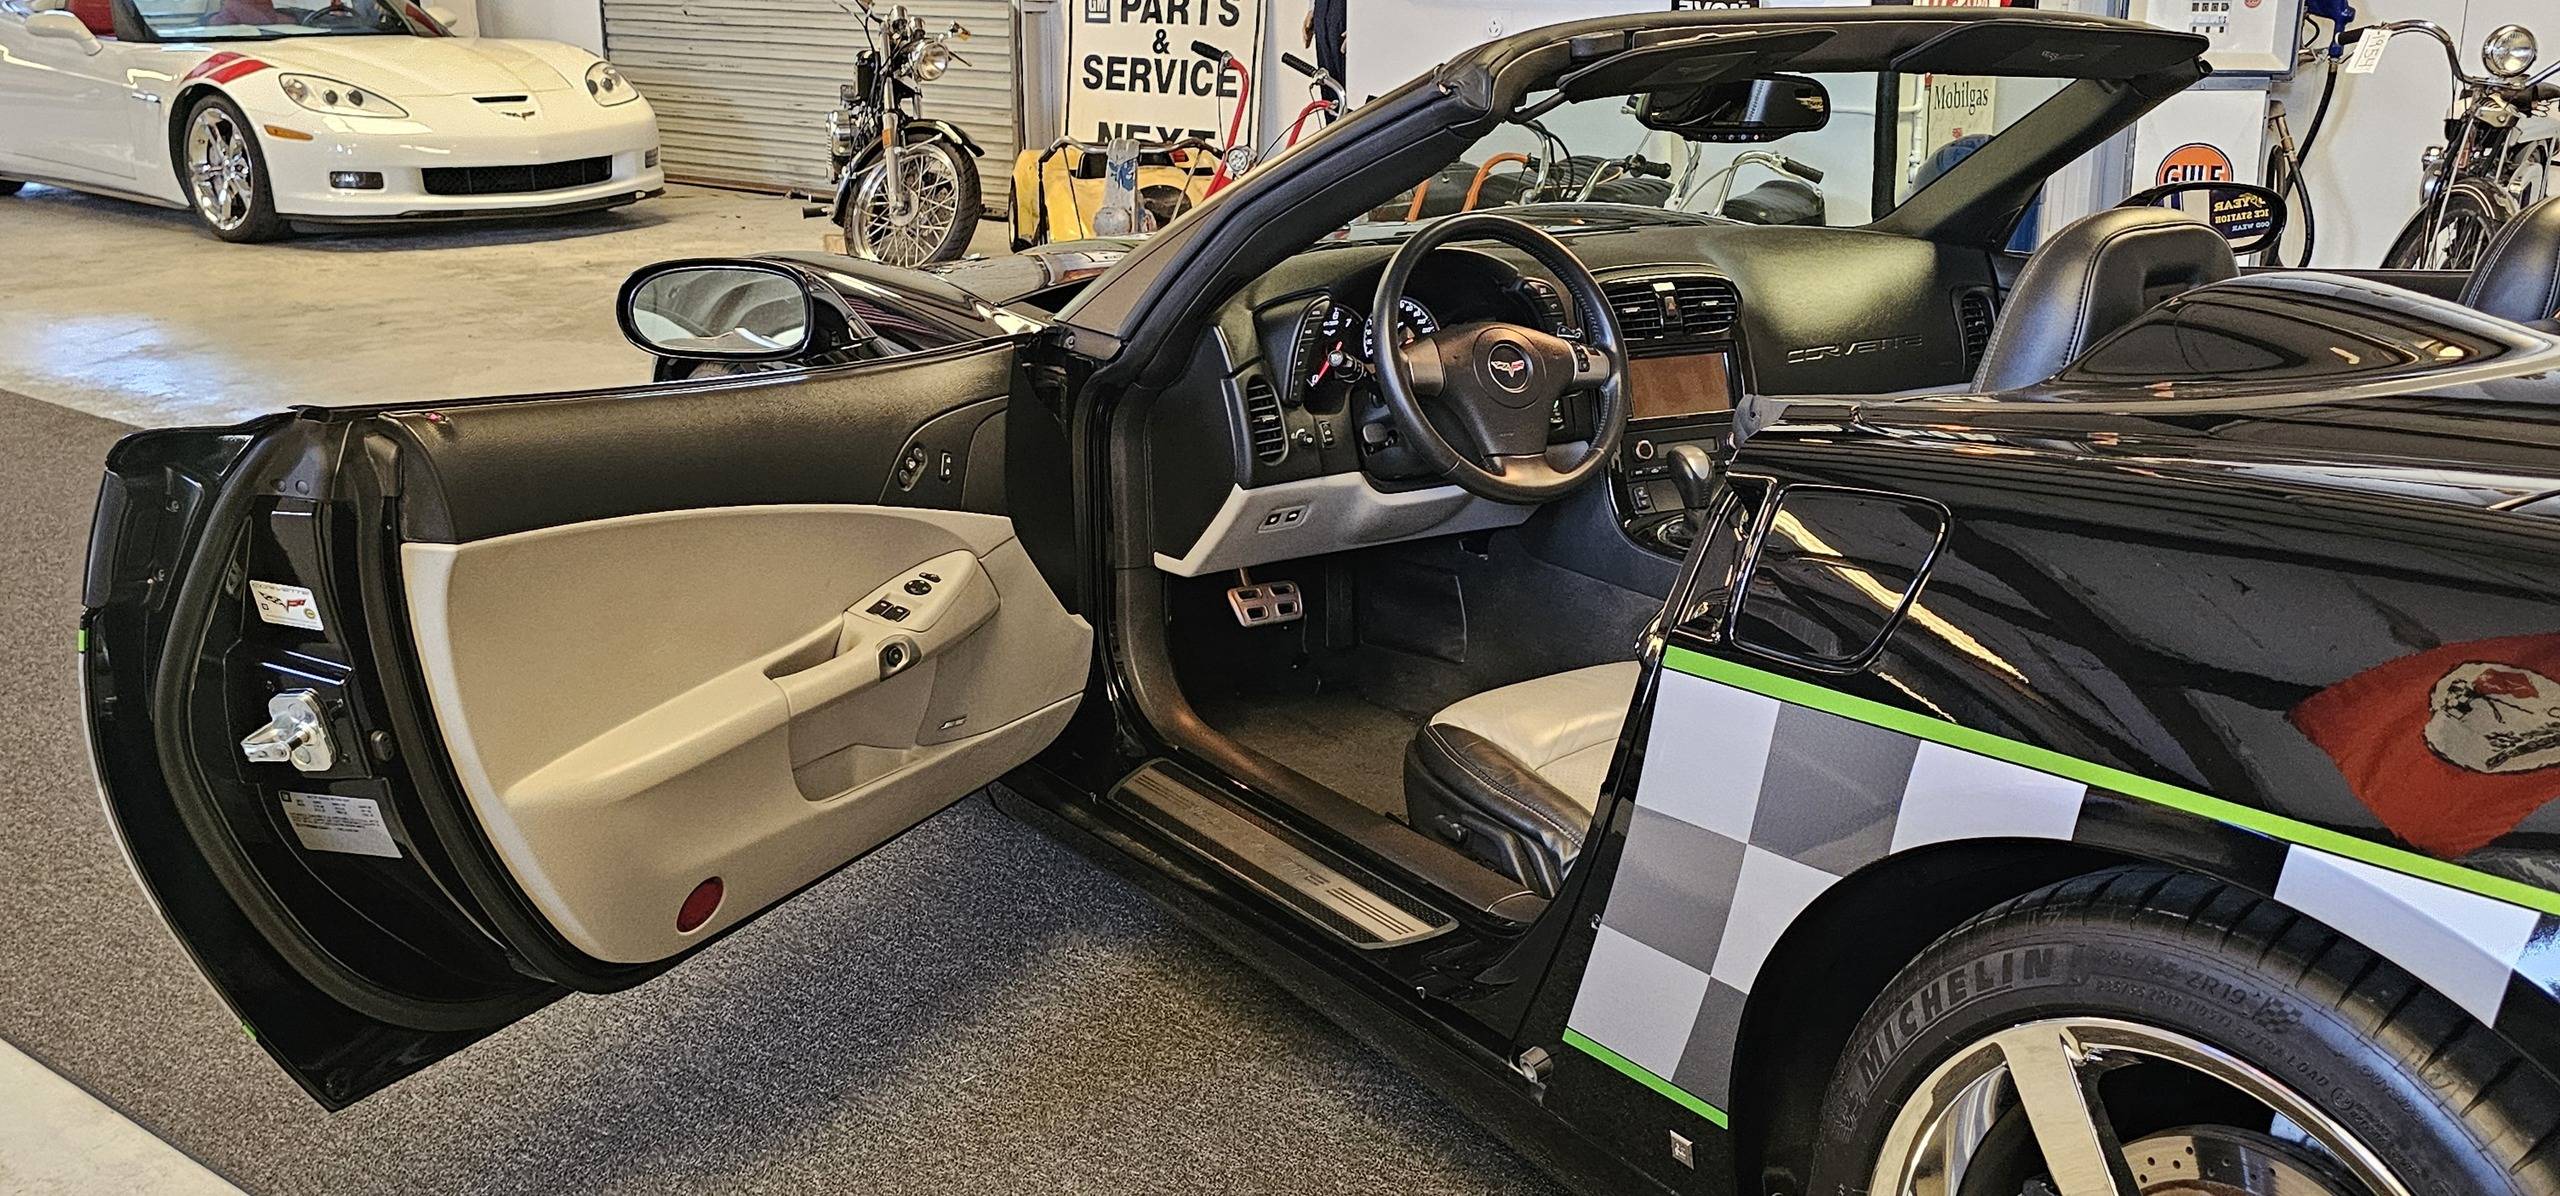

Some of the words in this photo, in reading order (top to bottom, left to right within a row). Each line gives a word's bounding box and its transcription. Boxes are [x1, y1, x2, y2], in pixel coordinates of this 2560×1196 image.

[1088, 0, 1107, 13] GM
[1120, 0, 1240, 27] PARTS
[1152, 29, 1170, 54] &
[1082, 54, 1238, 98] SERVICE
[1934, 80, 1989, 116] Mobilgas
[1787, 334, 1923, 364] CORVETTE
[1855, 948, 2054, 1090] MICHELIN
[2287, 1055, 2330, 1088] LOAD
